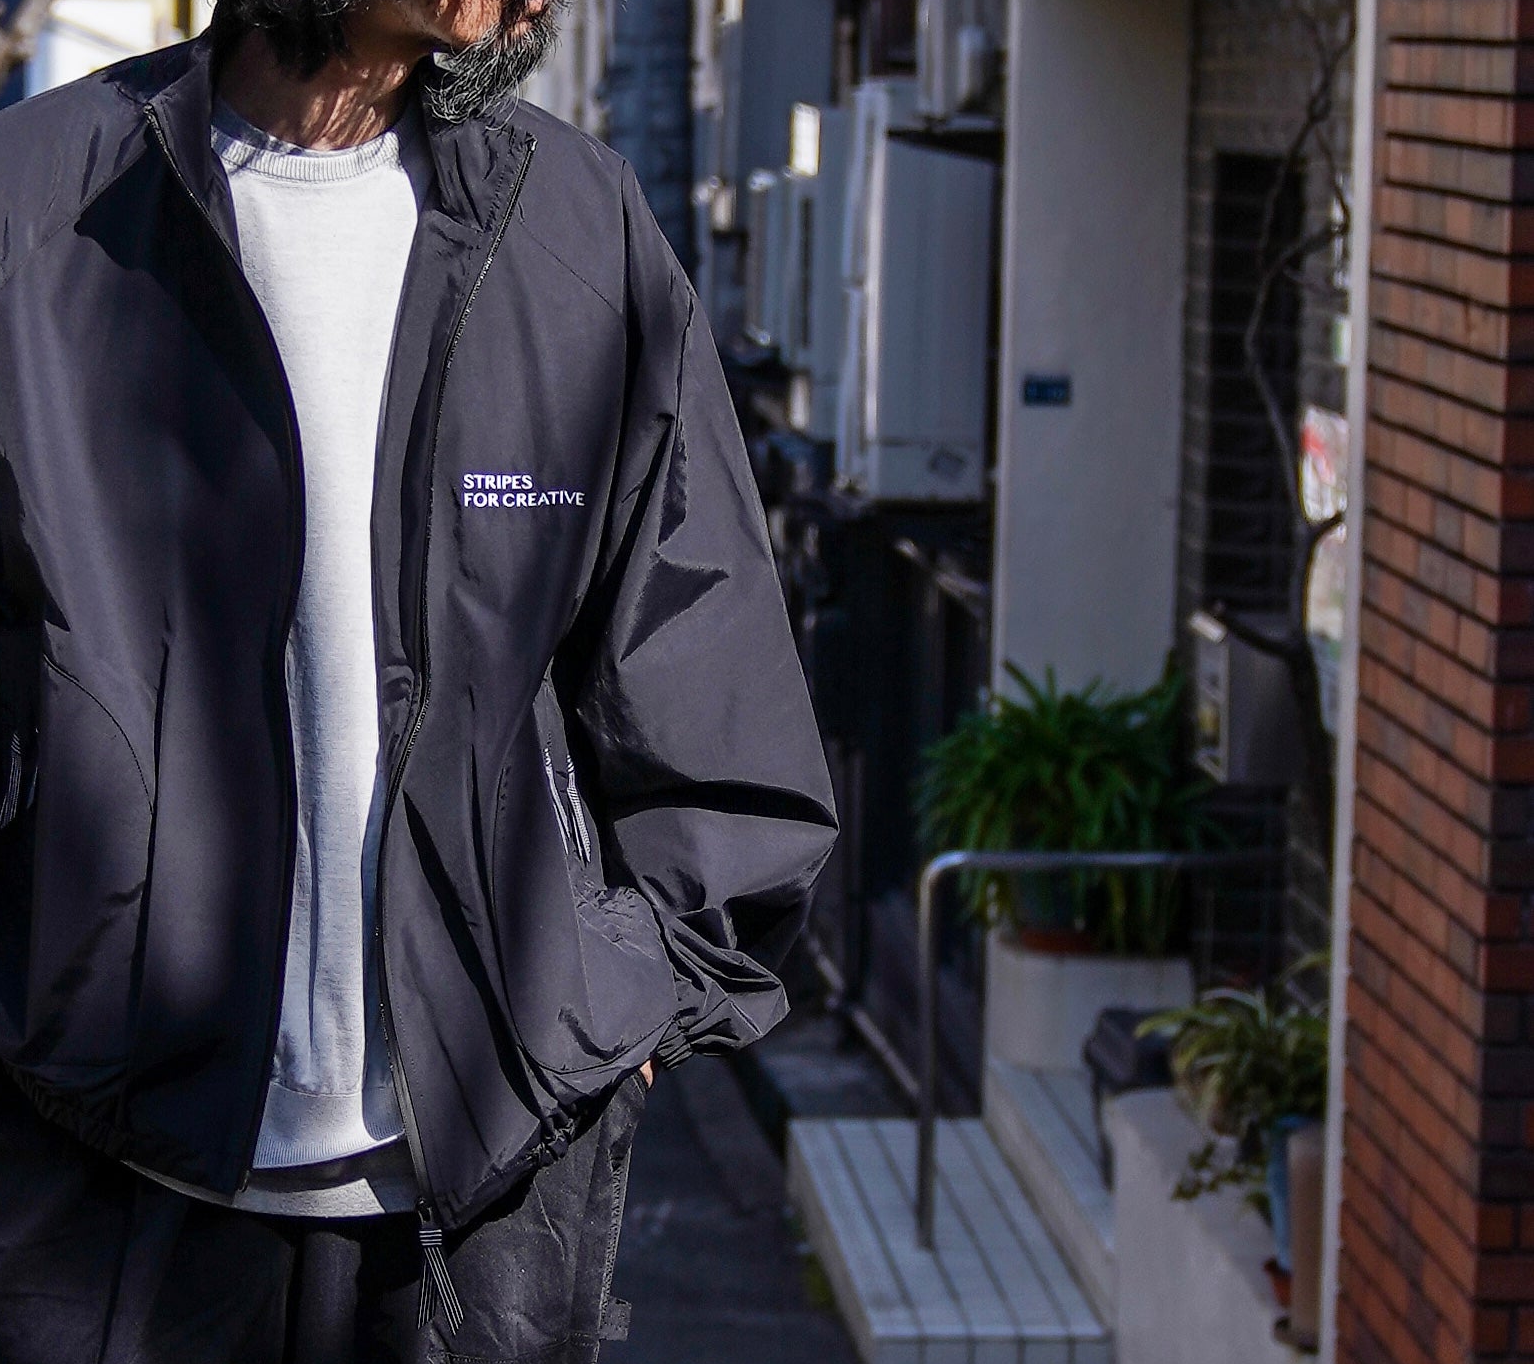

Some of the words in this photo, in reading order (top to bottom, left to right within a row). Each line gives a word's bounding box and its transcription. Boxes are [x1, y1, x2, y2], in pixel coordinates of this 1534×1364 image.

[463, 474, 533, 490] STRIPES
[464, 492, 499, 508] FOR
[502, 490, 585, 508] CREATIVE
